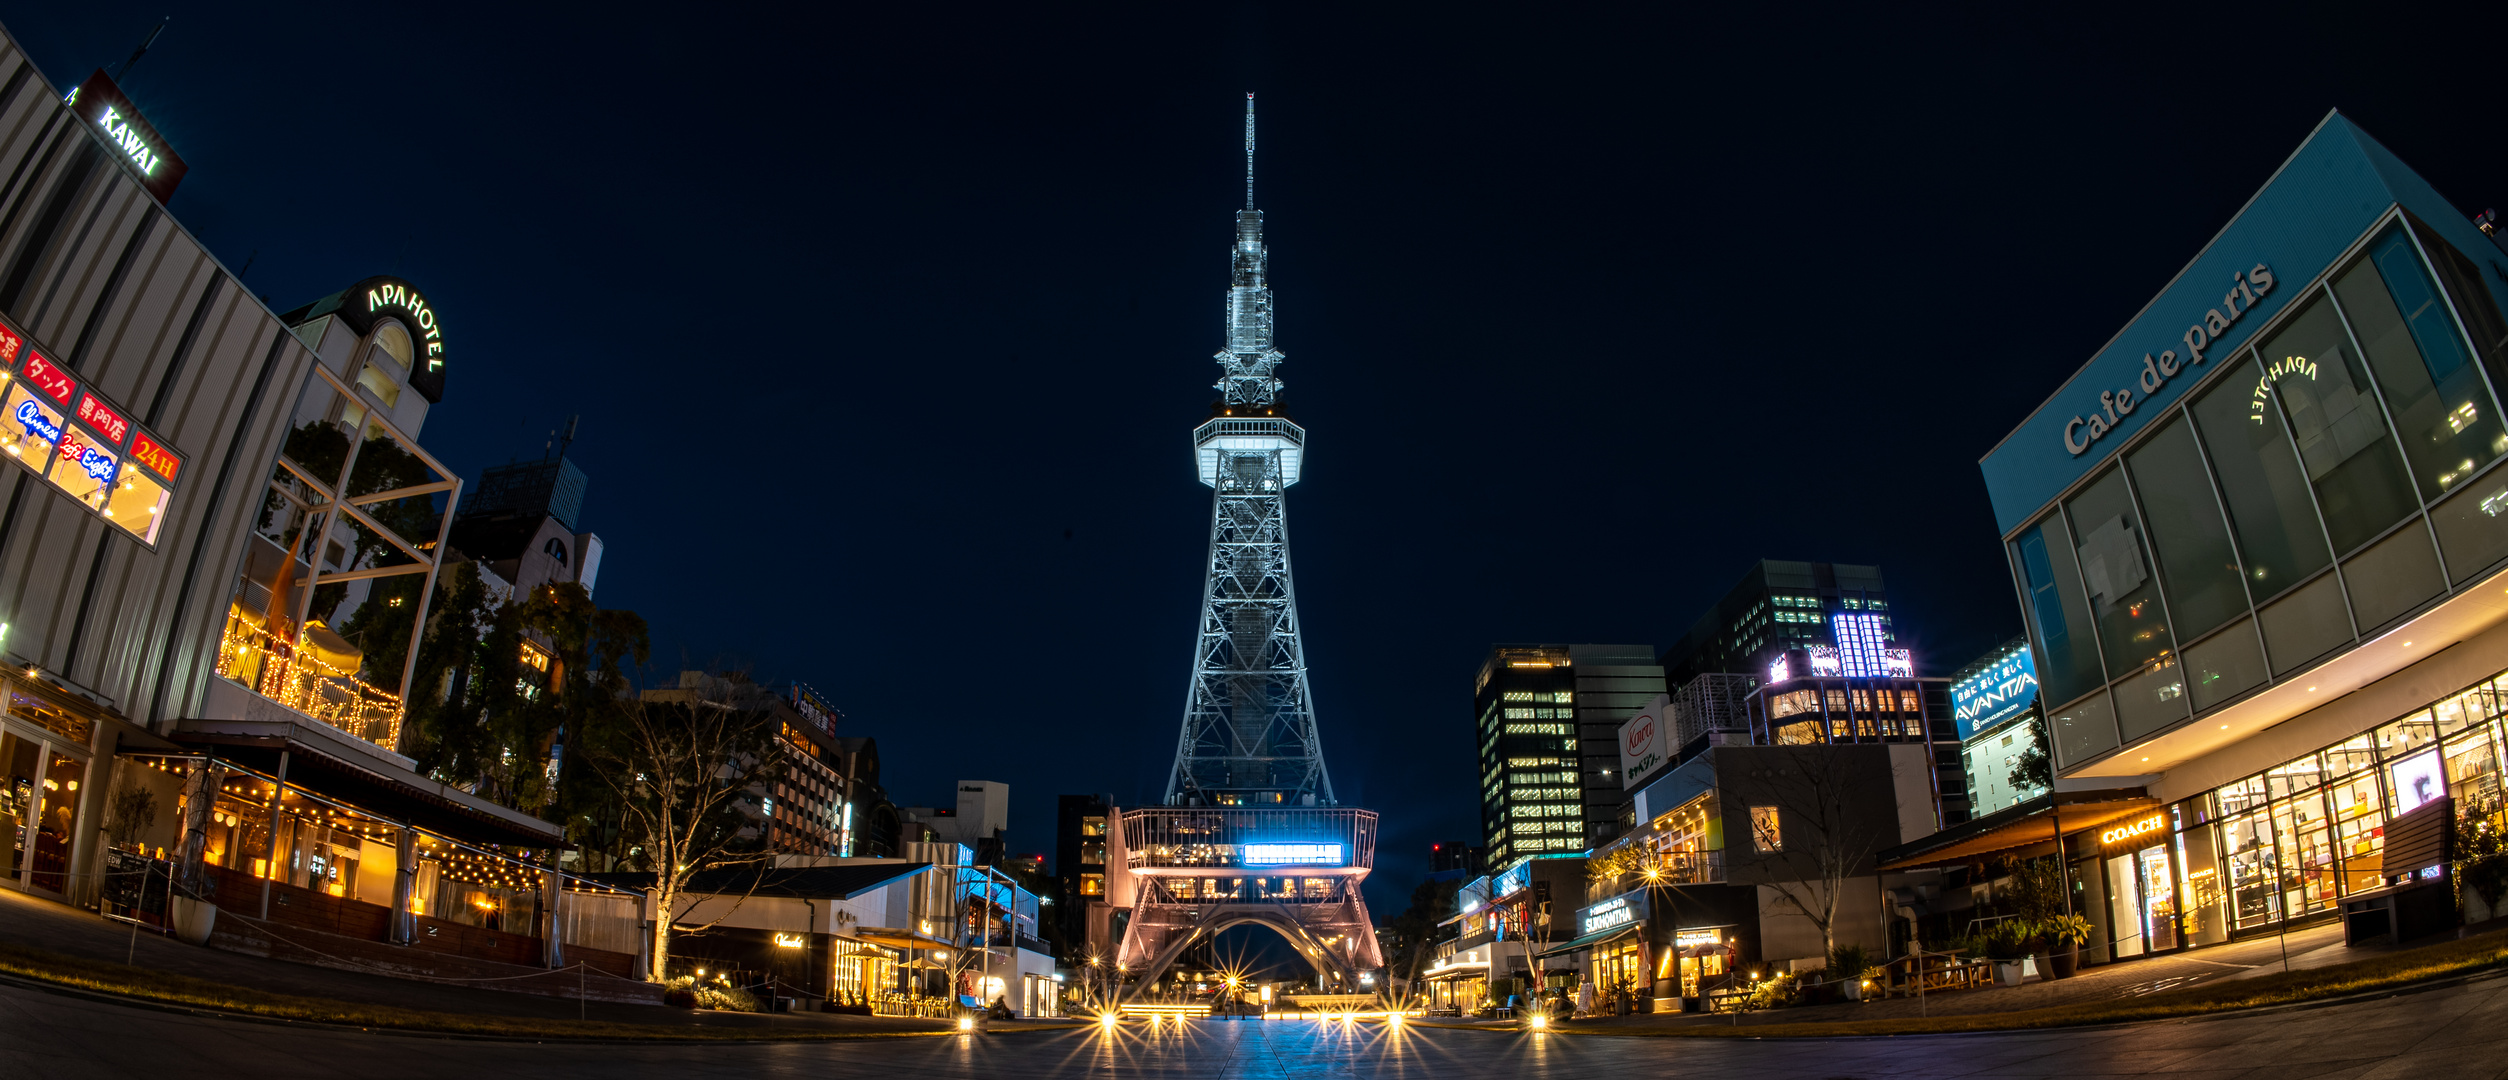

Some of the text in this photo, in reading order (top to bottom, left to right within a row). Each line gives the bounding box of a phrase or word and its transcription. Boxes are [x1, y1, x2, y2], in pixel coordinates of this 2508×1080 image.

[98, 106, 159, 175] KAWAI
[368, 284, 443, 373] APA HOTEL
[2064, 263, 2274, 455] Cafe de paris
[0, 331, 174, 478] 京 ダック 専門店 24H
[17, 401, 59, 441] Chinese
[82, 450, 114, 480] Eight
[1955, 671, 2038, 720] AVANTIA
[1957, 658, 2023, 703] 自由に 楽しく 美しく
[1628, 721, 1653, 753] Kowa
[2103, 815, 2163, 844] COACH
[2189, 868, 2215, 879] COACH
[1585, 906, 1632, 934] SUKHONTHA
